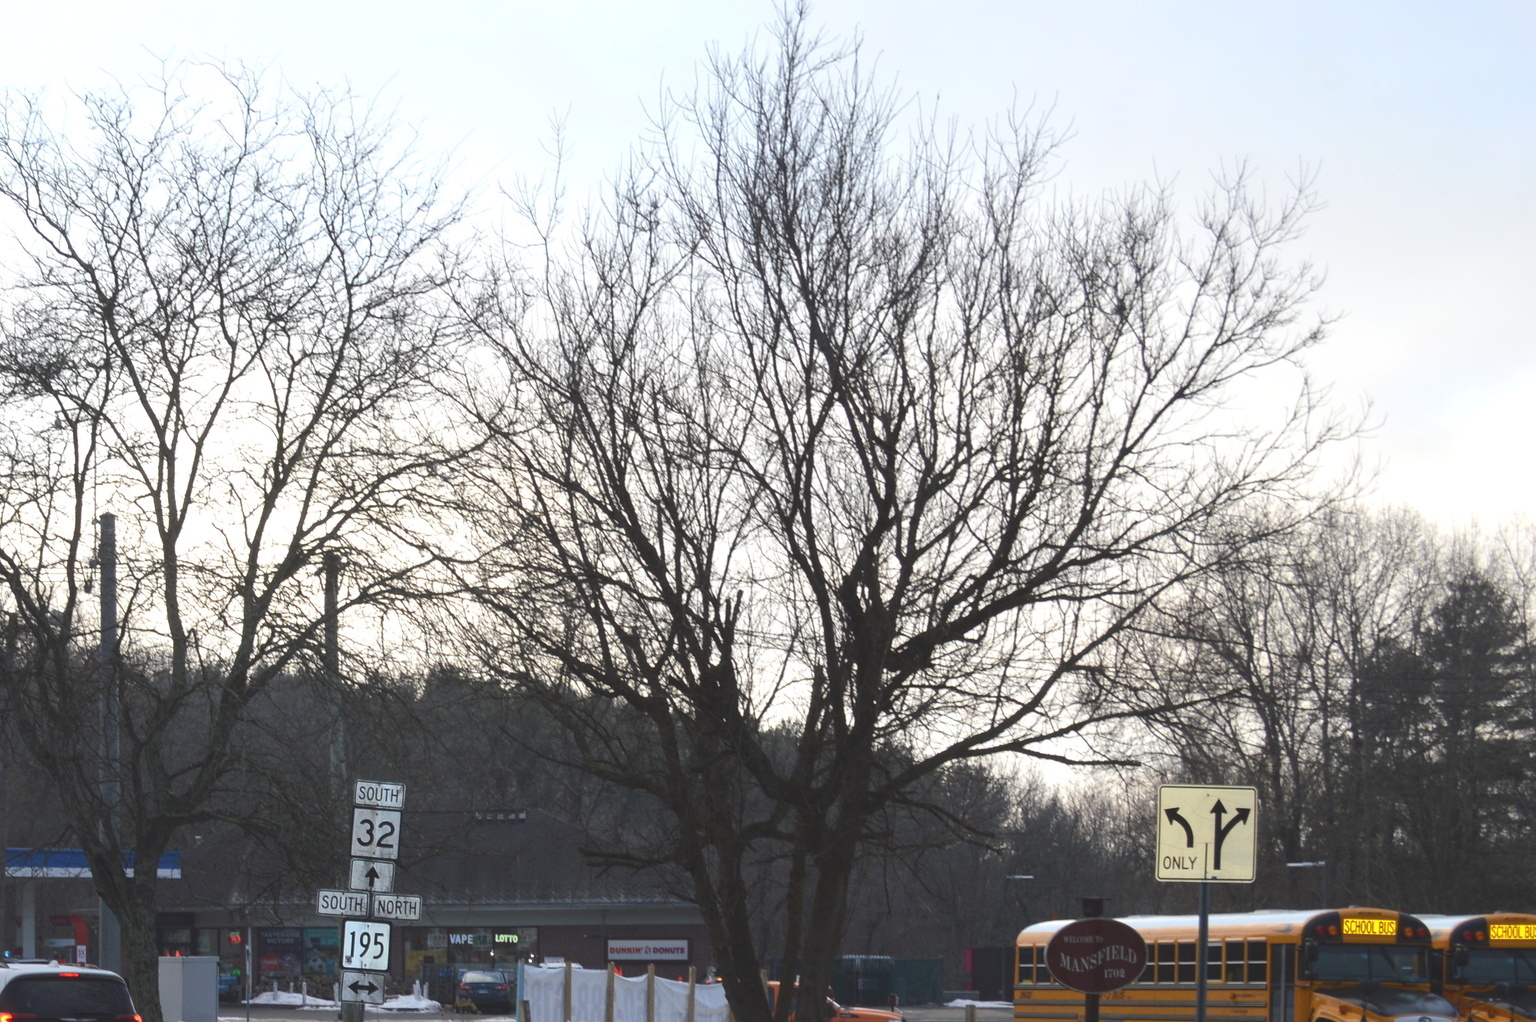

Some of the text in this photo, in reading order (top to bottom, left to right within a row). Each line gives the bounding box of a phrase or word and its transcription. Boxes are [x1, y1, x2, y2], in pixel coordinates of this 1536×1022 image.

[358, 786, 399, 803] SOUTH
[356, 819, 395, 848] 32
[1162, 856, 1198, 870] ONLY
[321, 895, 363, 912] SOUTH
[377, 900, 417, 915] NORTH
[1344, 920, 1395, 935] SCHOOL BUS
[1491, 925, 1523, 939] SCHOOL
[349, 931, 384, 960] 195
[449, 934, 474, 944] VAPE
[495, 934, 519, 943] LOTTO
[1063, 936, 1093, 944] WELCOME
[1060, 945, 1137, 972] MANSFIELD
[1104, 969, 1125, 978] 1702
